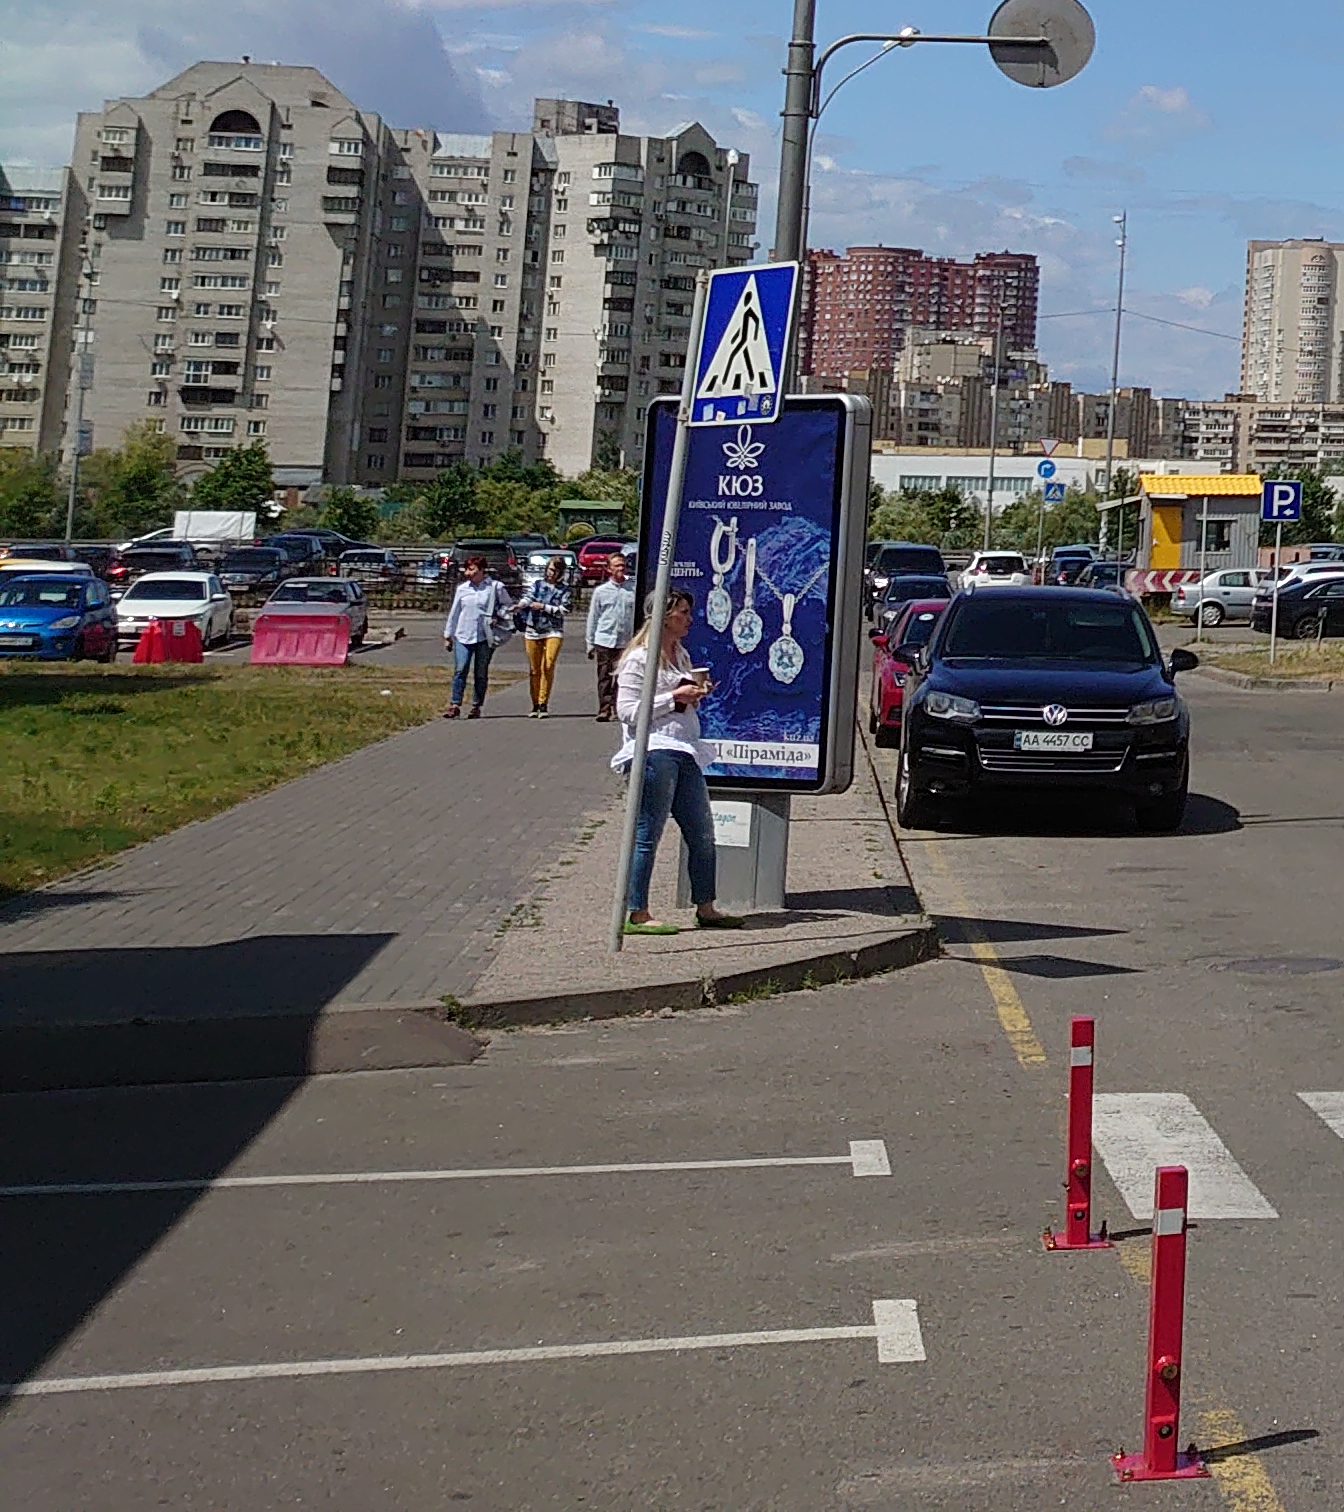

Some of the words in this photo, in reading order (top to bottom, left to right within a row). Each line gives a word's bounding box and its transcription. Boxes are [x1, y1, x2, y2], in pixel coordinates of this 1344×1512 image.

[717, 475, 764, 497] КЮЗ
[1271, 484, 1296, 517] P
[1022, 734, 1040, 746] AA
[1042, 734, 1070, 747] 4457
[1072, 735, 1090, 747] CC
[726, 744, 812, 764] «Піраміда»
